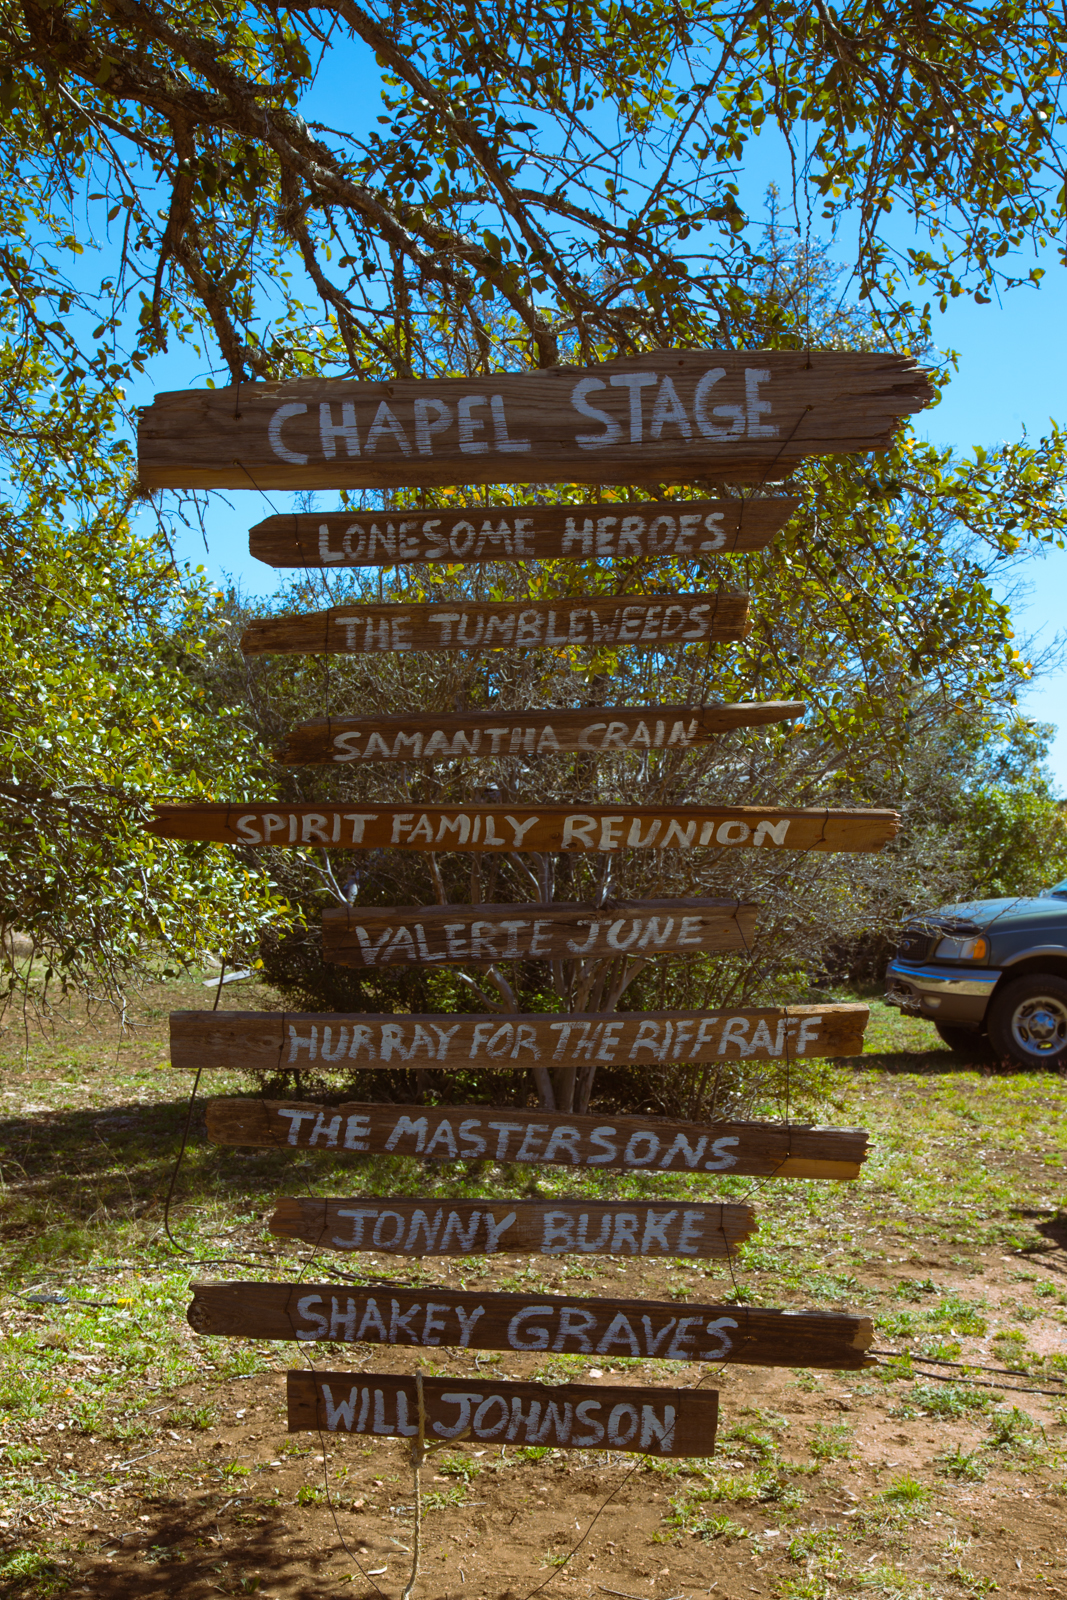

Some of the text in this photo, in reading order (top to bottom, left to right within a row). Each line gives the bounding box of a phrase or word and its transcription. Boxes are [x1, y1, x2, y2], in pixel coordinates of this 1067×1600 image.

[267, 367, 780, 466] CHAPEL STAGE
[318, 512, 727, 563] LONESOME HEROES
[335, 604, 711, 650] THE TUMBLEWEEDS
[332, 718, 698, 762] SAMANTHA CRAIN
[236, 813, 790, 850] SPIRIT FAMILY REUNION
[566, 916, 703, 953] JUNE
[287, 1024, 462, 1063] HURRAY
[469, 1022, 542, 1060] FOR
[550, 1021, 625, 1061] THE
[277, 1108, 740, 1170] THE MASTERSONS
[332, 1207, 705, 1254] JONNY BURKE
[295, 1294, 739, 1360] SHAKEY GRAVES
[321, 1384, 676, 1451] WILL JOHNSON
